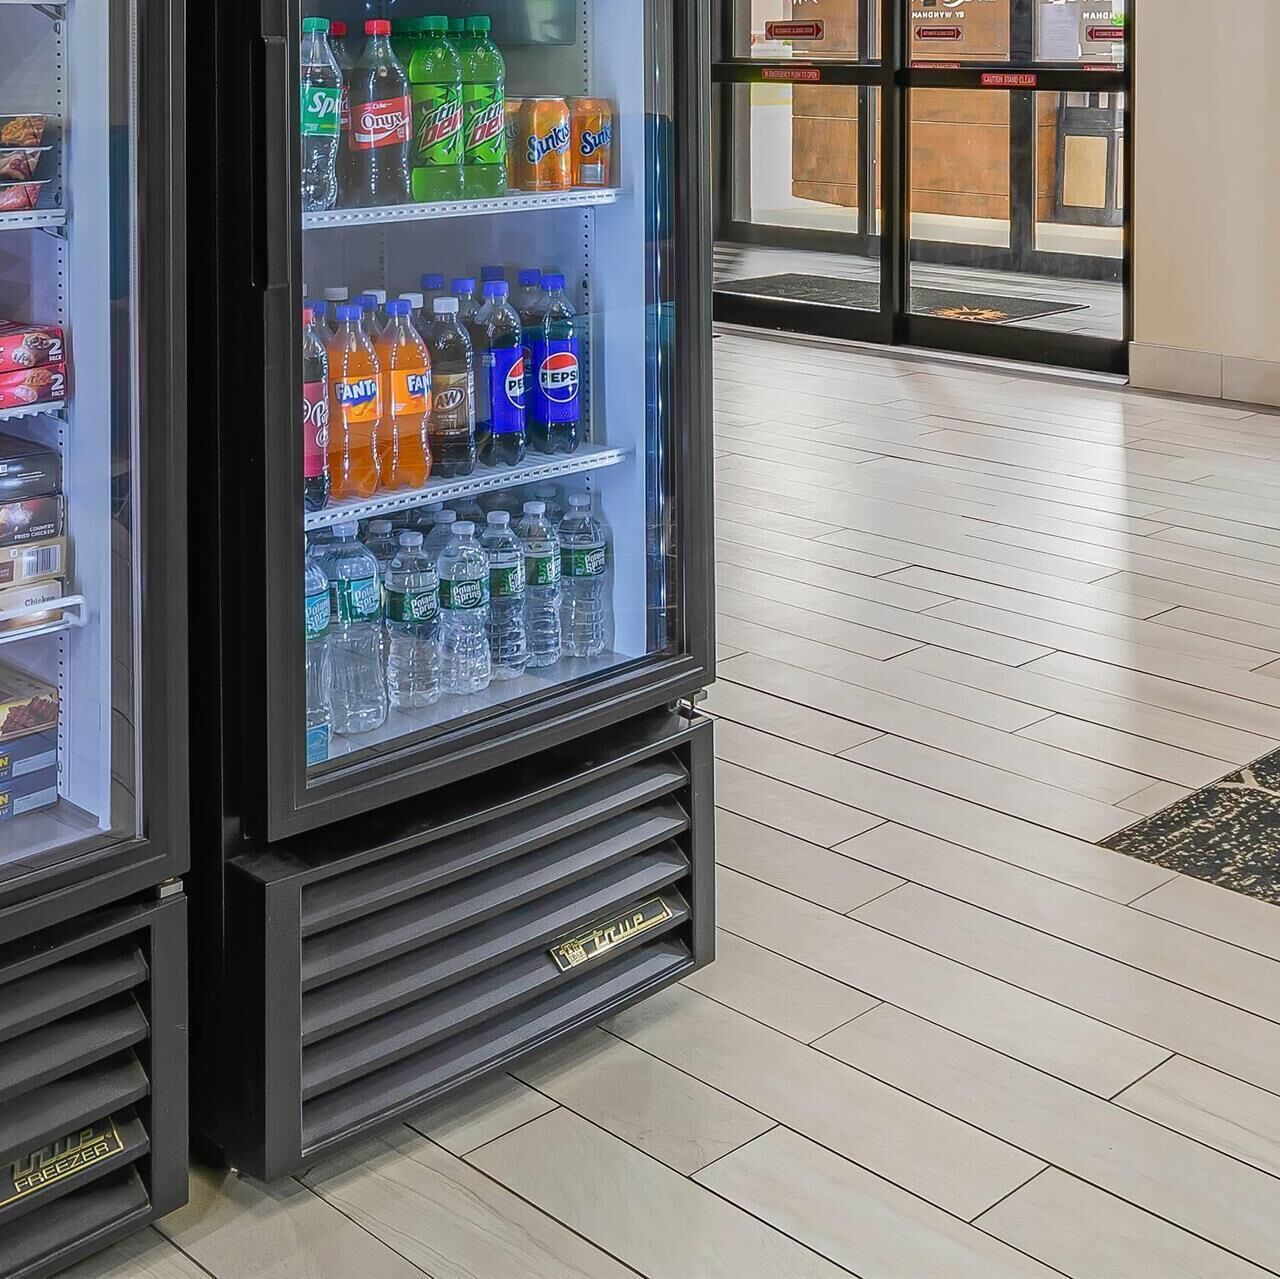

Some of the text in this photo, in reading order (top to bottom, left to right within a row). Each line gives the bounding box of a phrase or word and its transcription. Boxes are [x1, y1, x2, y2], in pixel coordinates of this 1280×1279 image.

[983, 74, 1036, 84] CAUTION STAND CLEAR
[49, 339, 62, 354] 2
[51, 374, 64, 390] 2
[14, 528, 55, 540] FRIED CHICKEN
[29, 523, 55, 532] COUNTRY
[24, 593, 56, 608] Chicken
[14, 1142, 110, 1192] FREEZER
